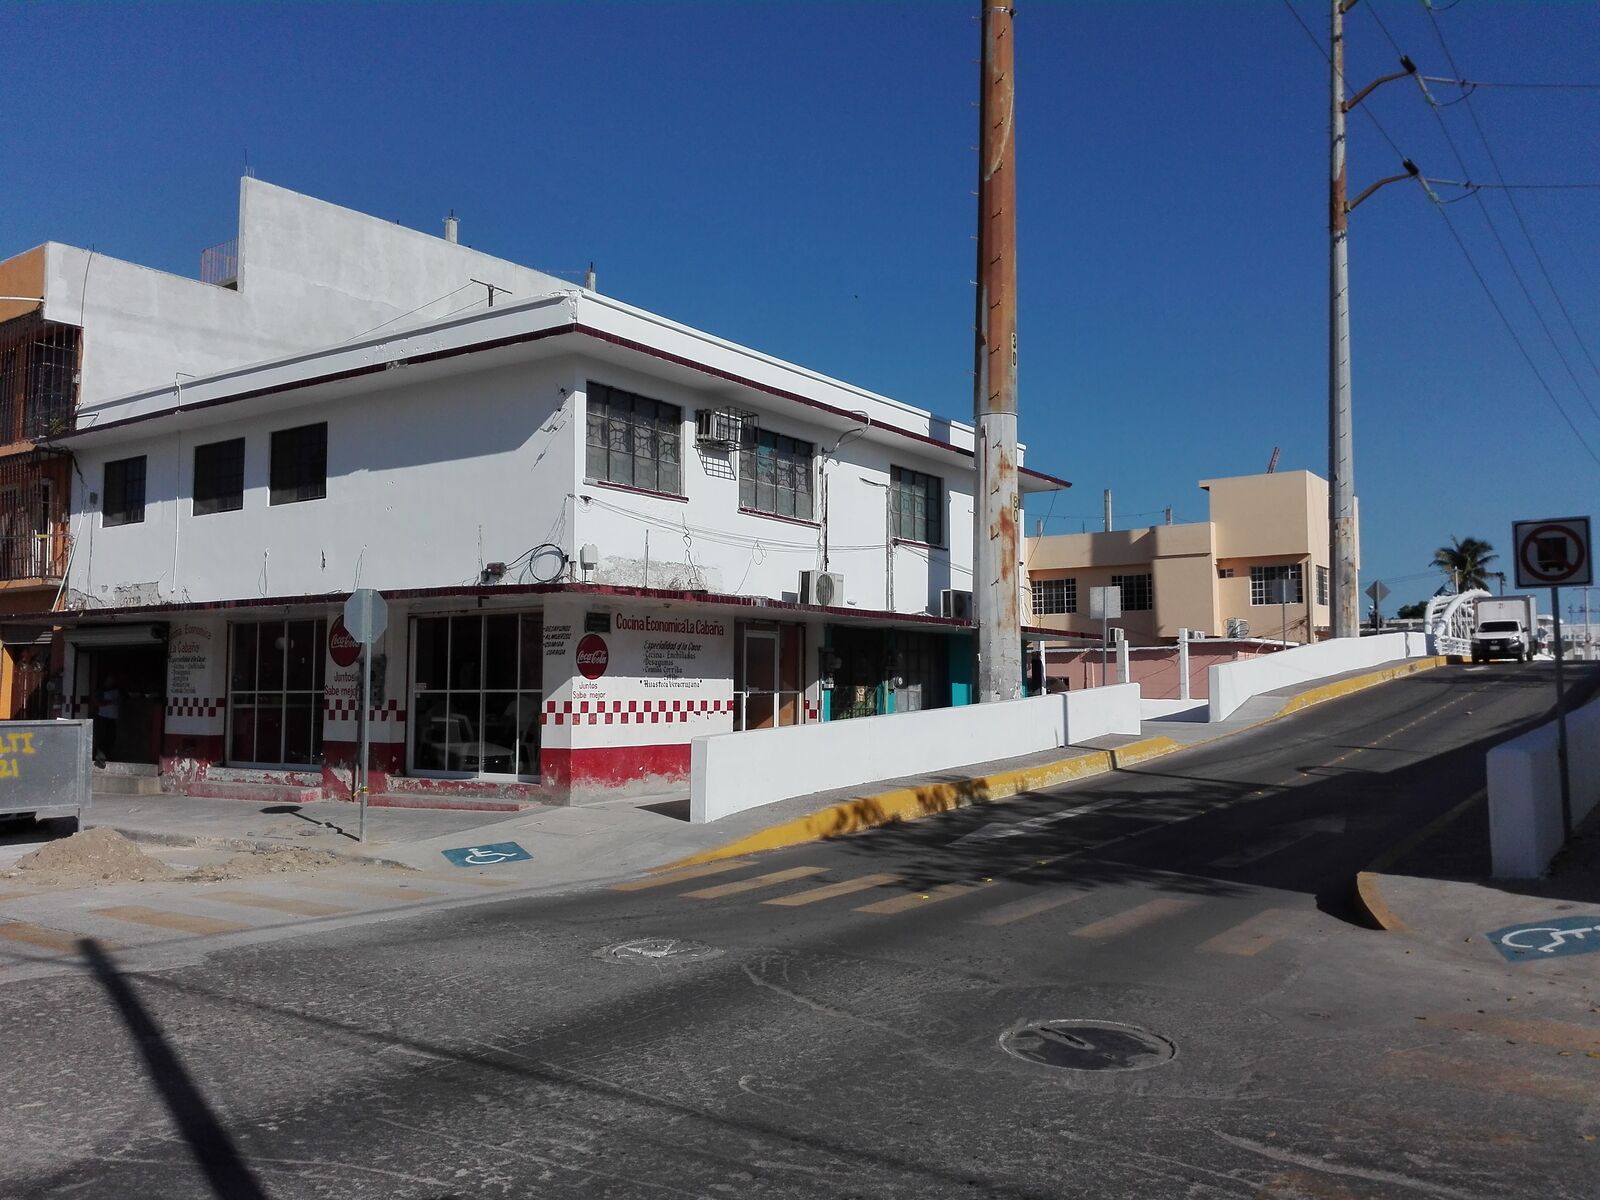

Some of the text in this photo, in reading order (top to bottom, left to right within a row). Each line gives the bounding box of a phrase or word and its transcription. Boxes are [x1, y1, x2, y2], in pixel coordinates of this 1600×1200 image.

[616, 613, 644, 630] Cocina
[686, 619, 695, 634] La
[695, 619, 724, 635] Cabaña
[577, 650, 607, 664] Coca-Cola
[579, 681, 598, 689] Juntos
[572, 690, 606, 700] Sabe mejor
